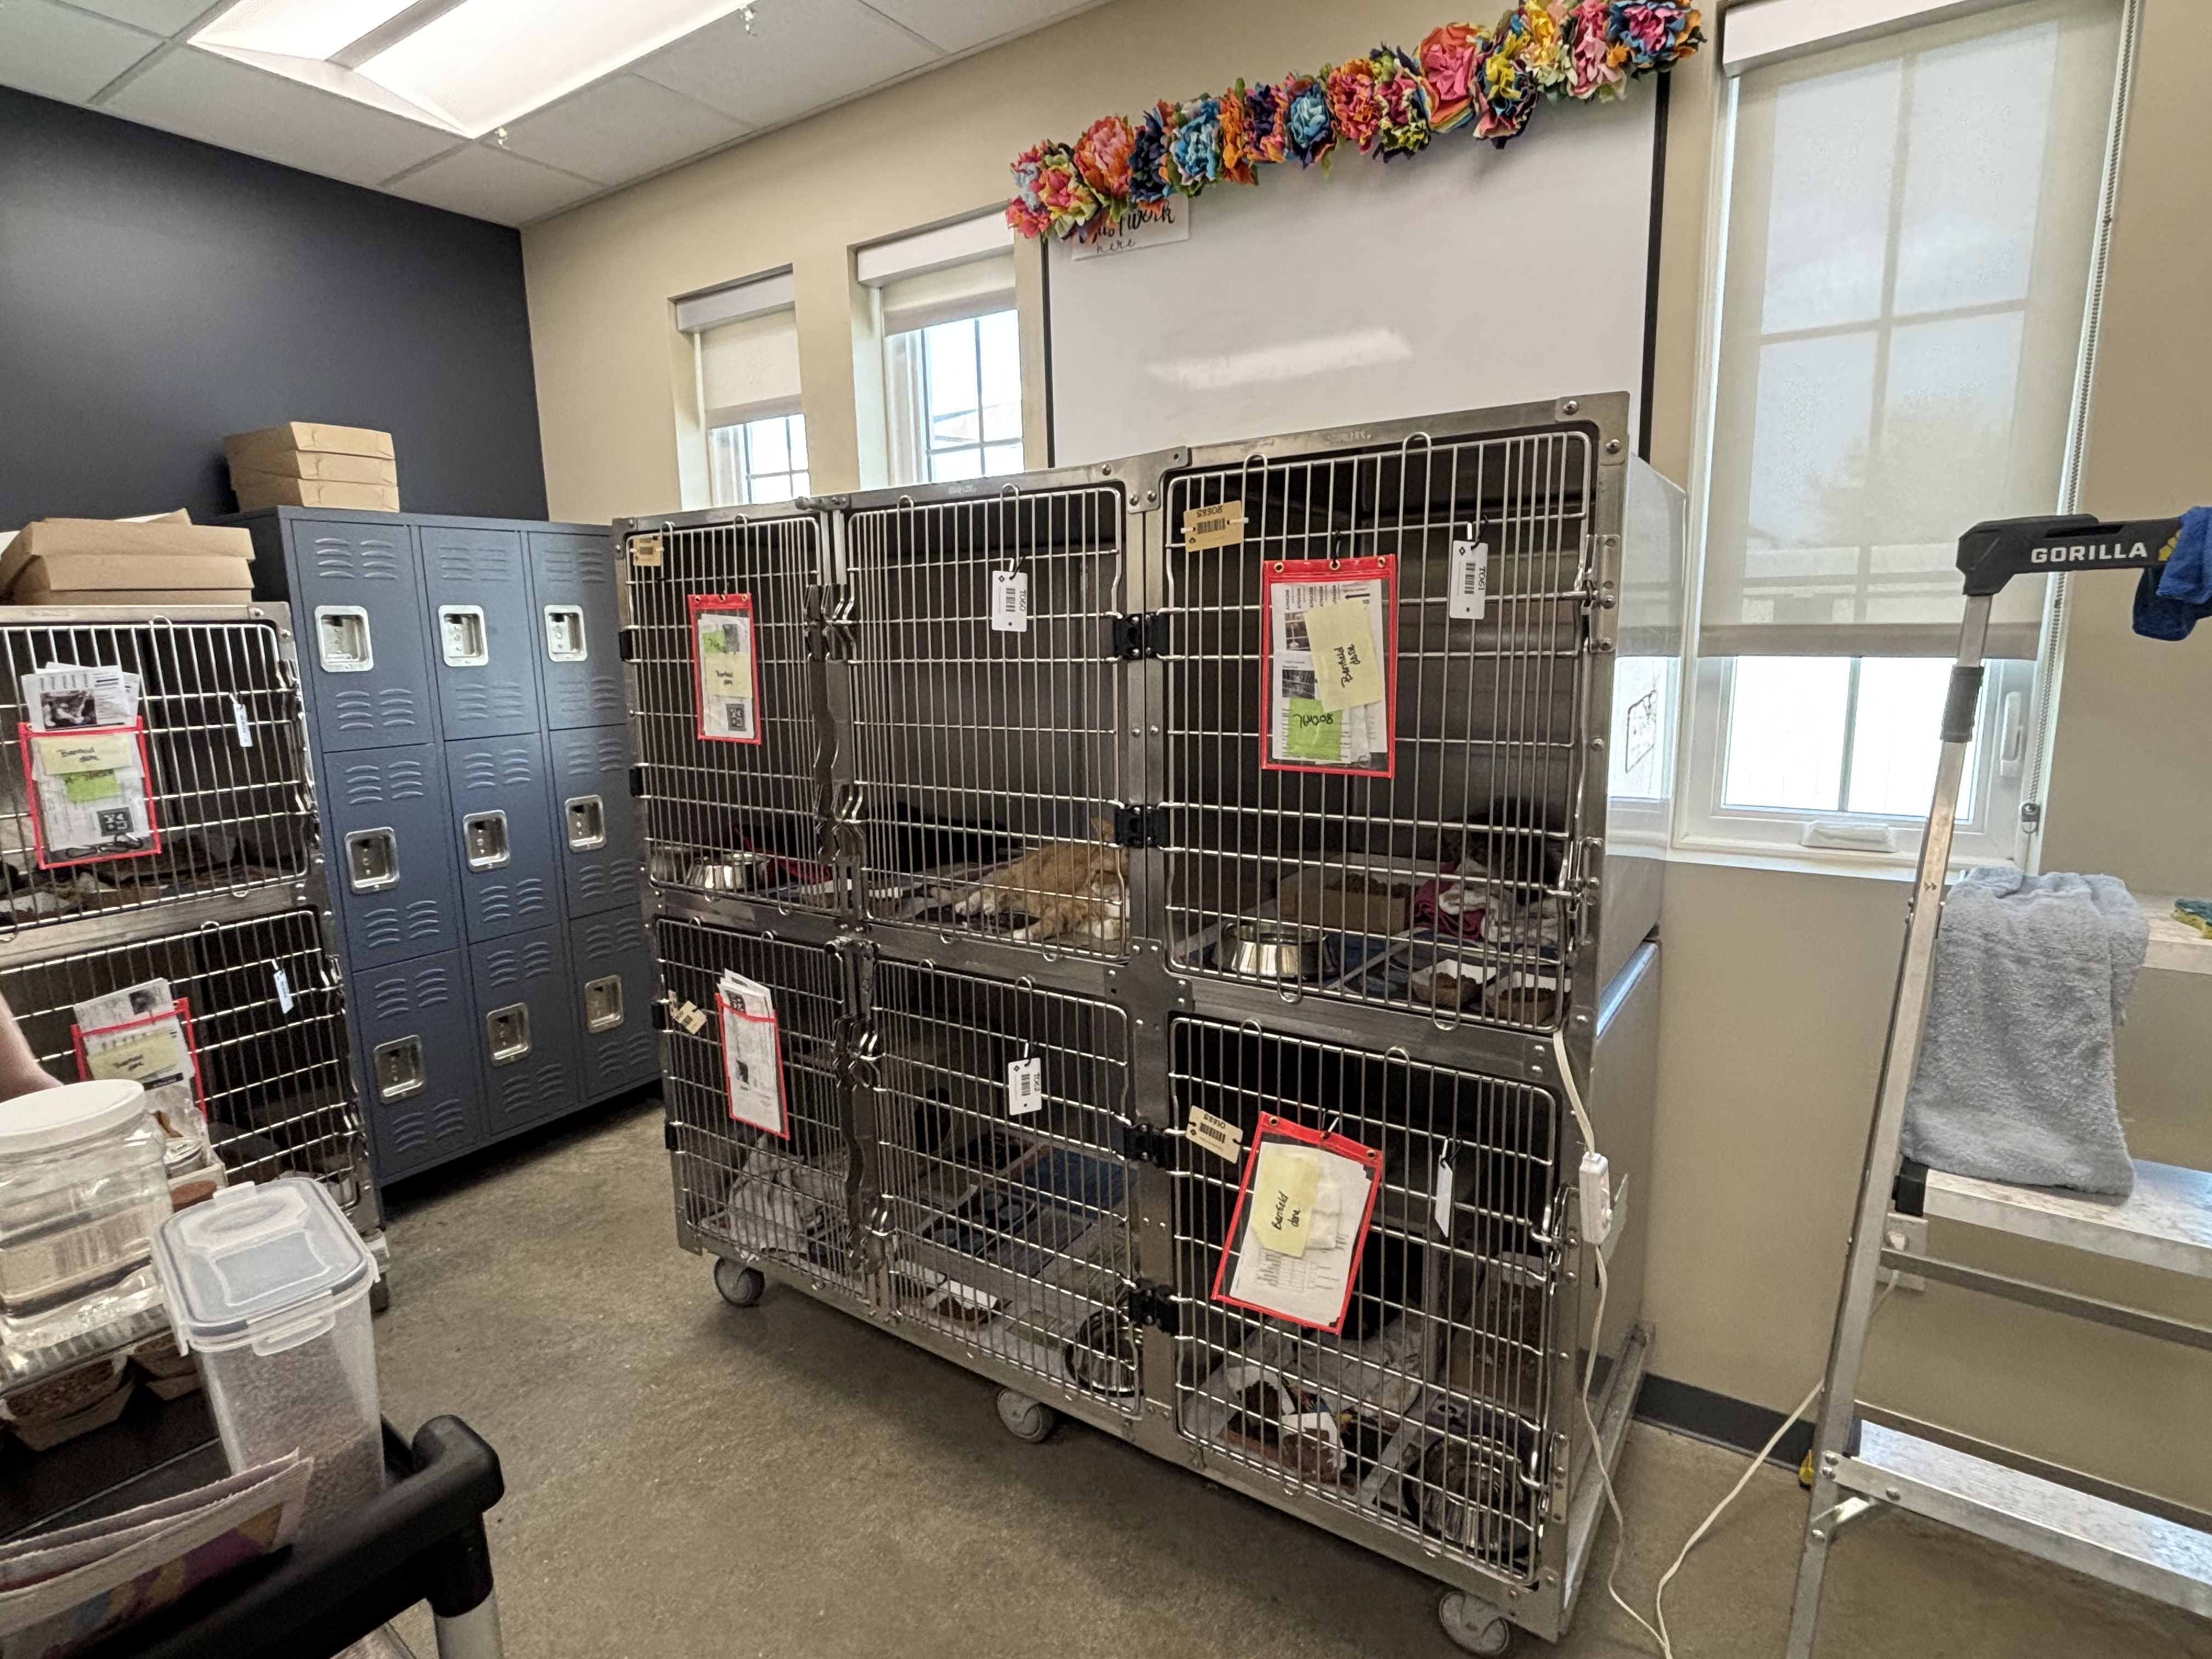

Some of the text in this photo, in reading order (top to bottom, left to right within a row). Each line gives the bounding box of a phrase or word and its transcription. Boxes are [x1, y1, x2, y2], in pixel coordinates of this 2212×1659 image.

[1097, 238, 1136, 253] here
[1196, 505, 1223, 517] S3305
[2031, 542, 2147, 563] GORILLA
[1347, 644, 1361, 665] done
[1287, 1209, 1301, 1227] done
